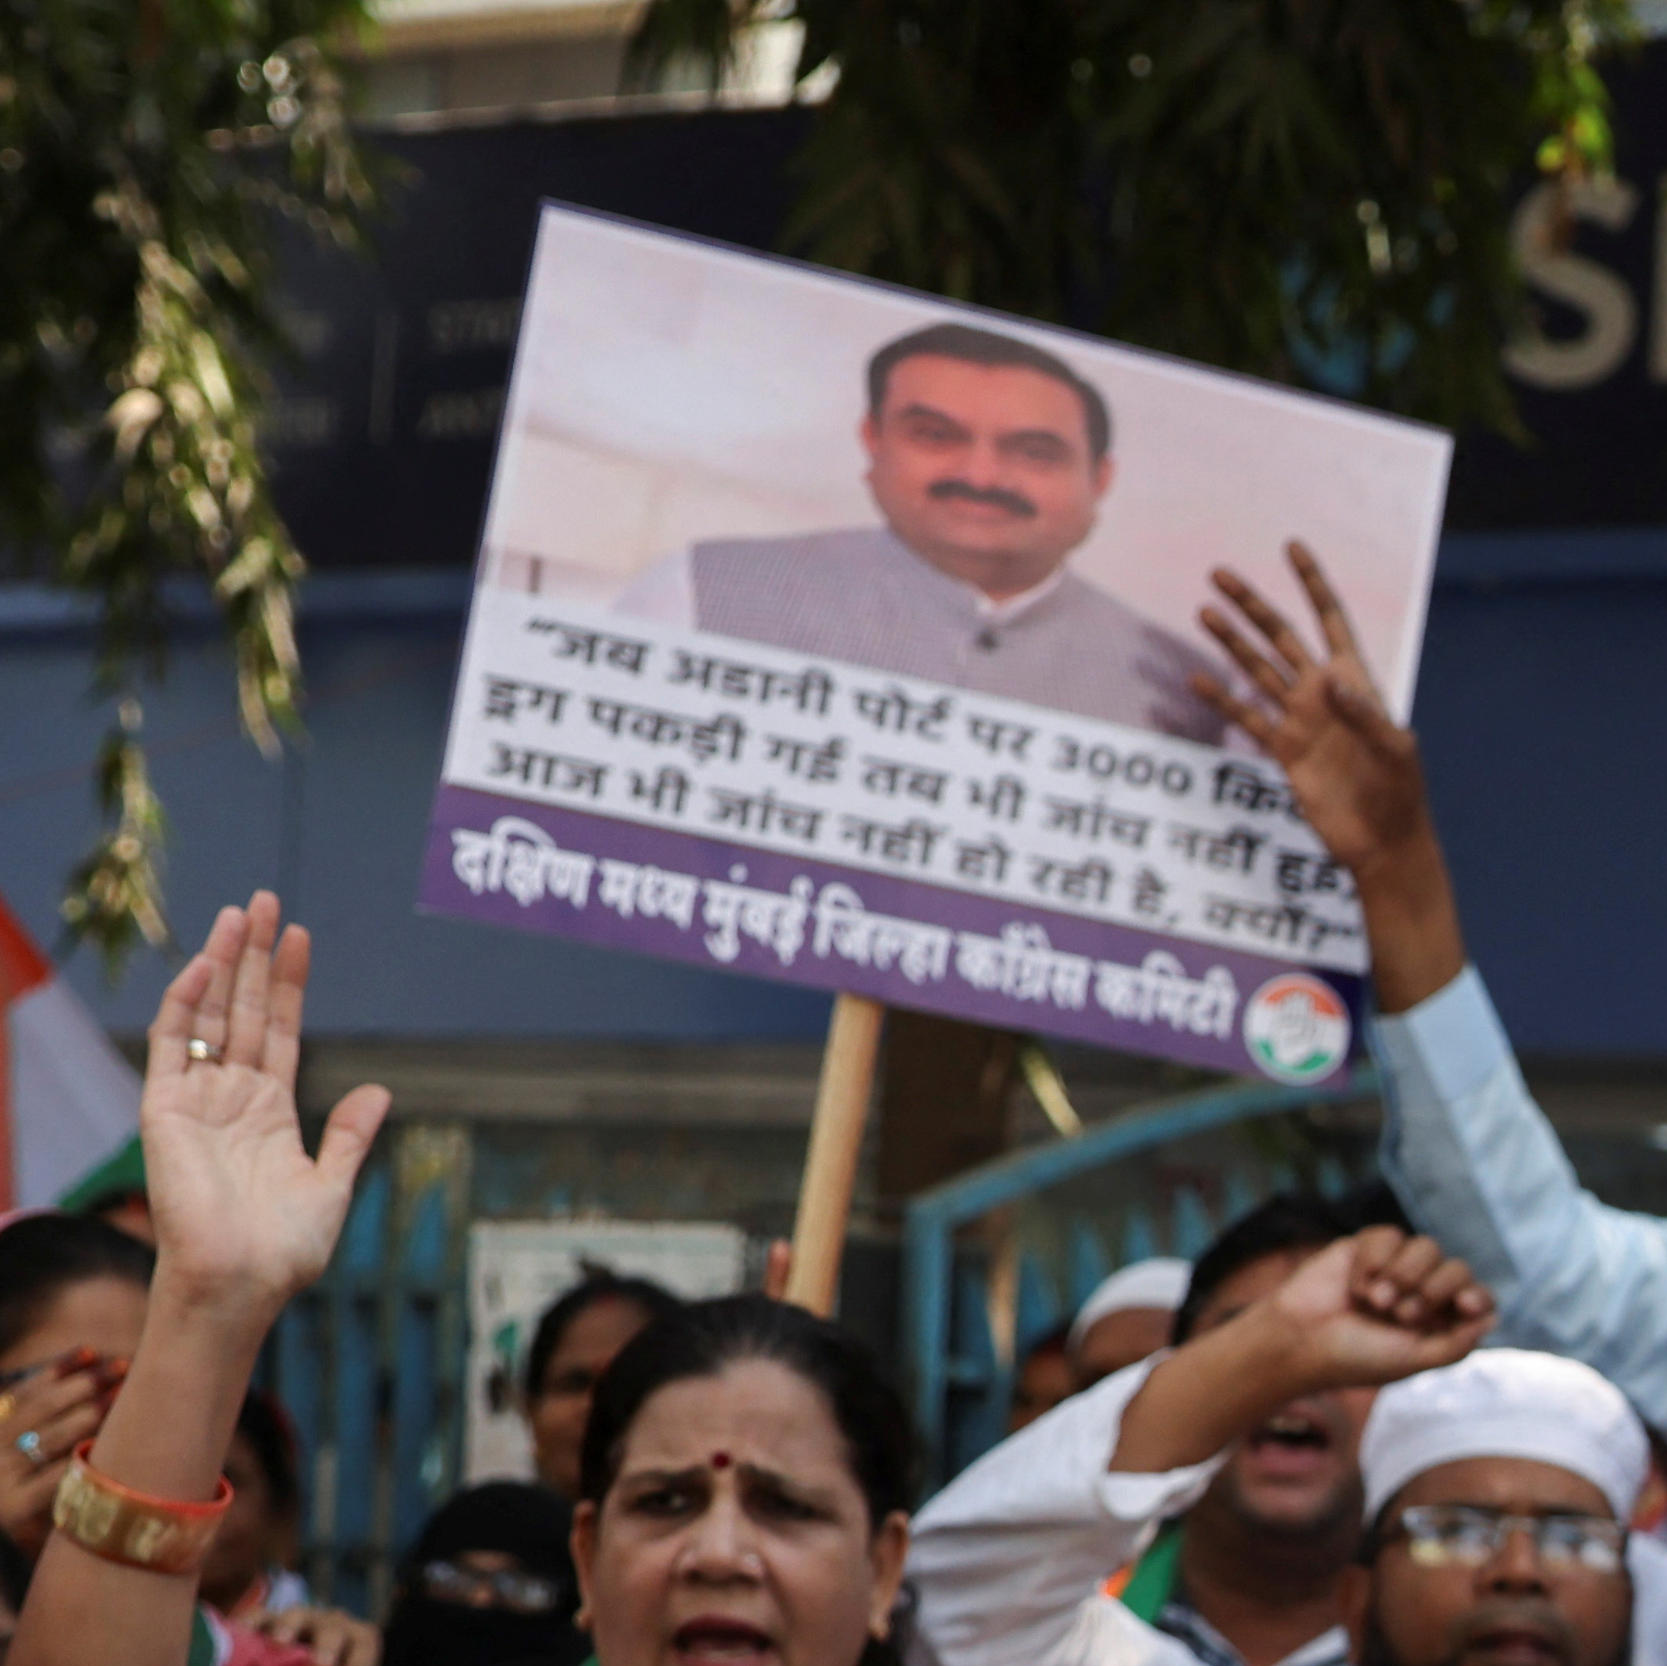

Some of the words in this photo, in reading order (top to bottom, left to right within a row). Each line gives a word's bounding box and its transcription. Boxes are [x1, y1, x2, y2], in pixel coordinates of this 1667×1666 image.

[586, 694, 749, 764] पकड़ी
[764, 733, 848, 785] गई
[861, 753, 950, 807] तब
[966, 770, 1025, 822] भी
[1044, 793, 1153, 849] जांच
[665, 647, 837, 719] अडानी
[853, 682, 952, 740] पोर्ट
[963, 707, 1039, 761] पर
[1051, 735, 1195, 798] 3000
[488, 741, 608, 798] आज
[626, 762, 690, 816] भी
[707, 785, 828, 845] जांच
[953, 836, 1012, 882] हो
[1028, 853, 1114, 904] रही
[450, 815, 597, 911] दक्षिण
[598, 856, 705, 931] मध्य
[701, 861, 817, 968] मुंबई
[812, 881, 953, 986] जिल्हा
[1094, 948, 1241, 1043] कमिटी
